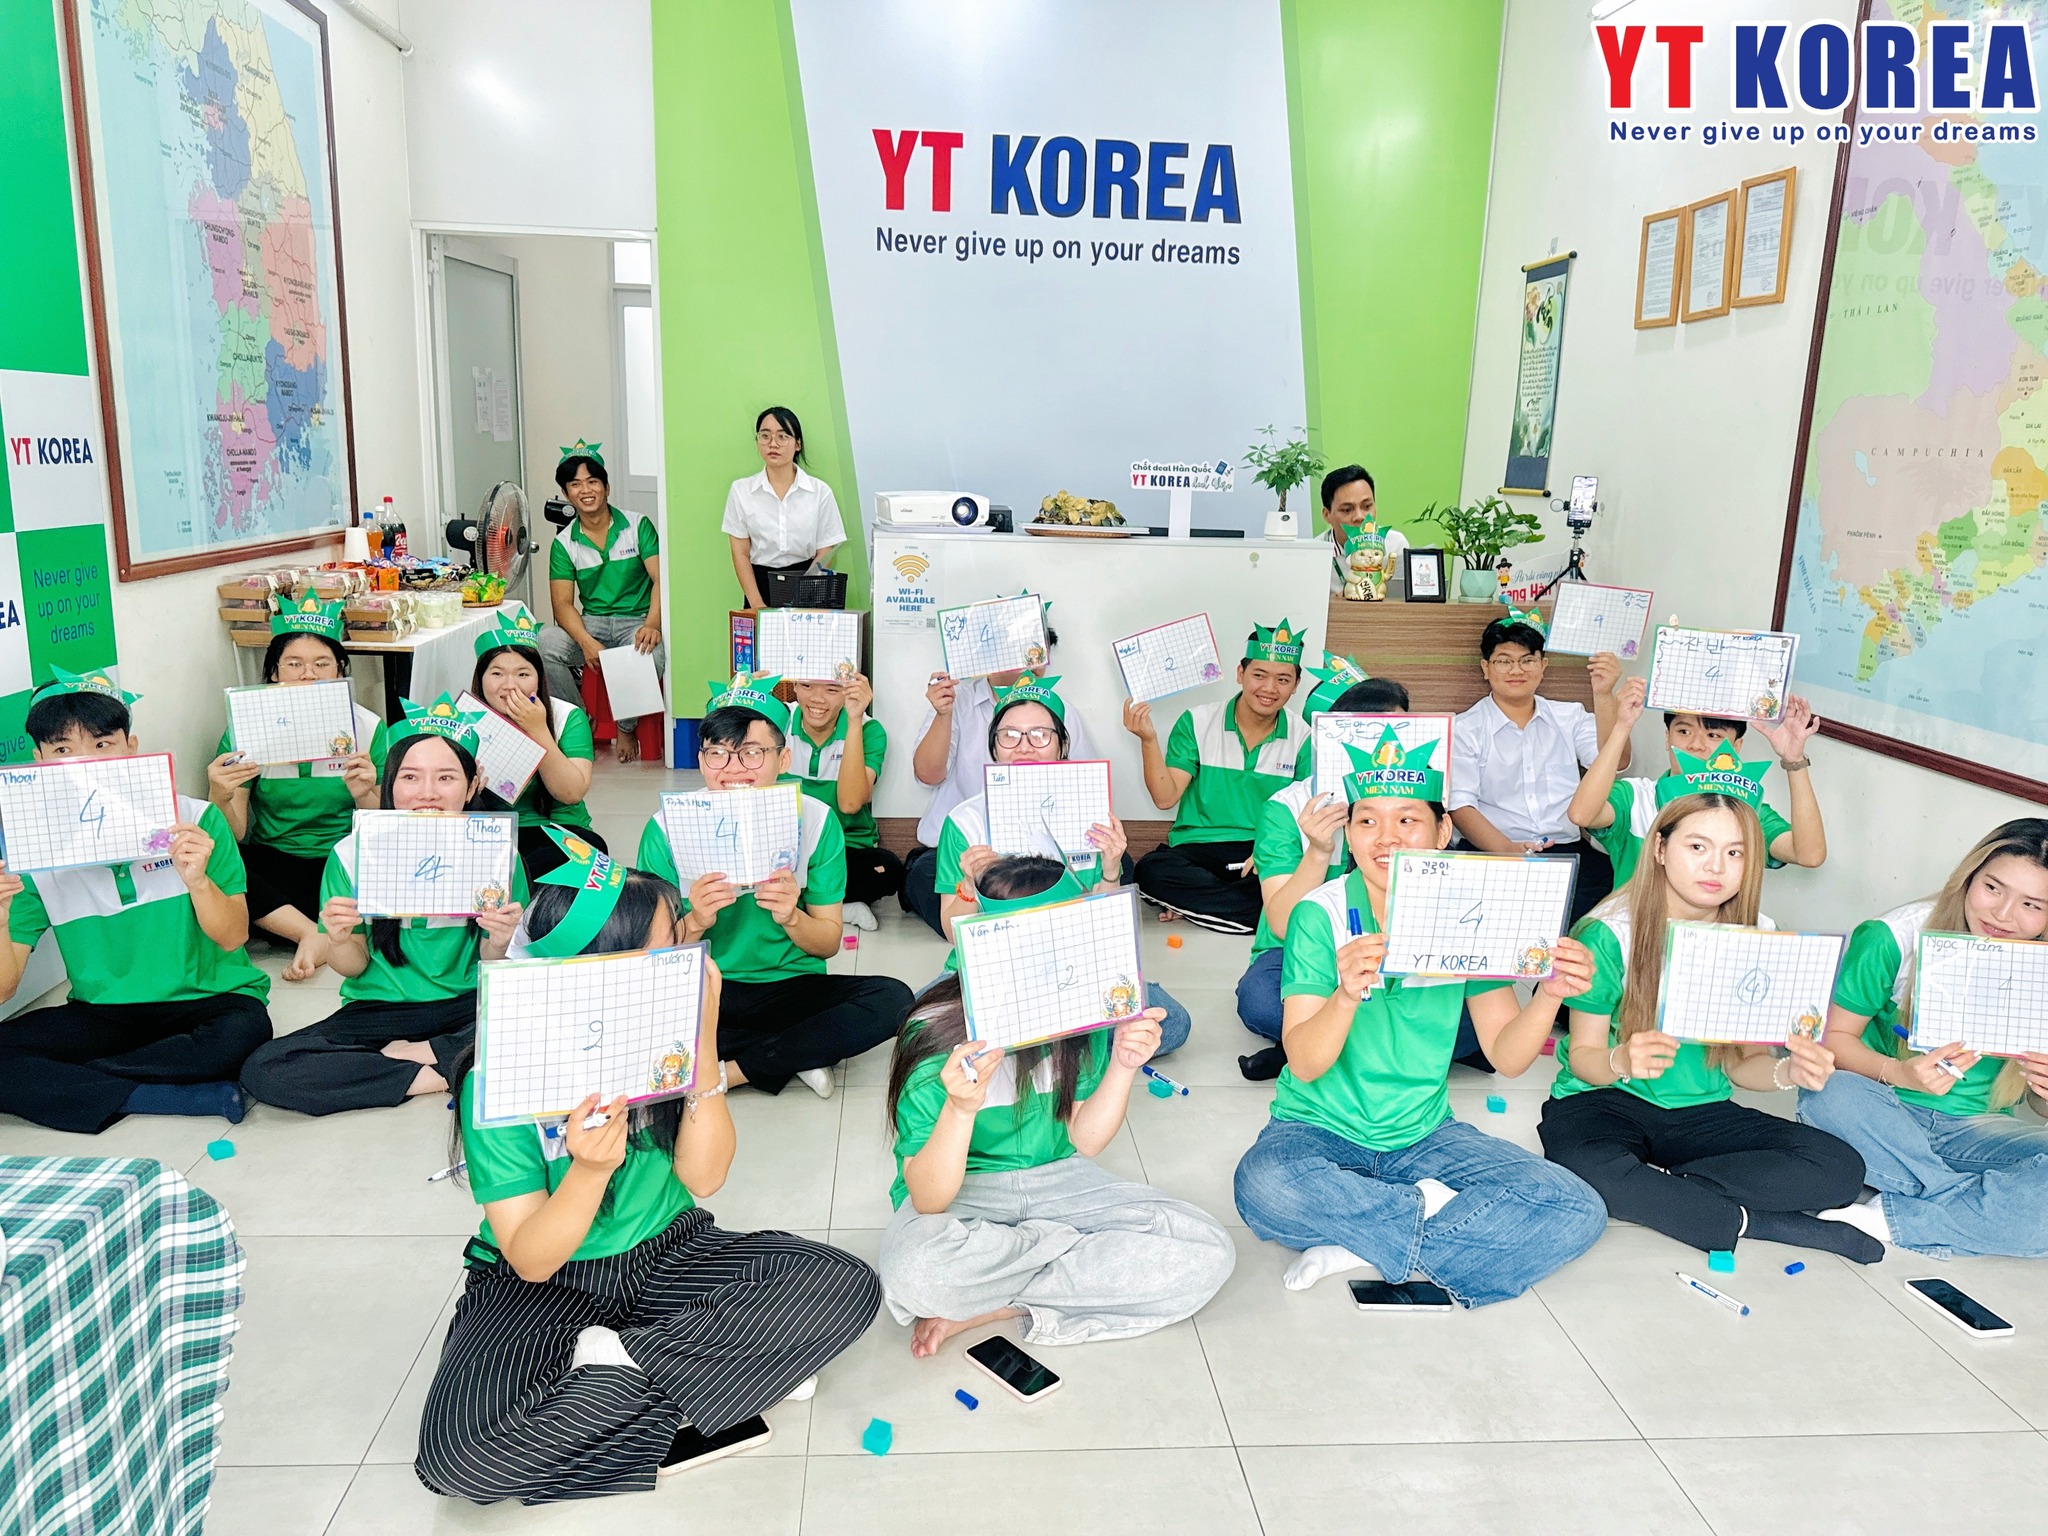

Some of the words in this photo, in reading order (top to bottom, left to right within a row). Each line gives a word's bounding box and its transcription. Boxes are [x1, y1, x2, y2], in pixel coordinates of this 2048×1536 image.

[872, 128, 964, 213] YT
[990, 133, 1242, 224] KOREA
[876, 227, 948, 254] Never
[955, 230, 1006, 262] give
[1015, 237, 1044, 264] up
[1052, 240, 1081, 259] on
[1091, 242, 1144, 267] your
[1151, 239, 1241, 265] dreams
[10, 437, 32, 465] YT
[37, 437, 94, 465] KOREA
[1132, 461, 1151, 471] Chốt
[1153, 464, 1171, 472] deal
[1173, 464, 1190, 472] Hàn
[1191, 463, 1212, 473] Quốc
[1133, 474, 1147, 486] YT
[1150, 475, 1190, 488] KOREA
[33, 567, 71, 589] Never
[75, 565, 98, 588] give
[37, 599, 54, 621] up
[57, 596, 73, 615] on
[76, 592, 100, 617] your
[886, 596, 935, 604] AVAILABLE
[51, 618, 95, 644] dreams
[284, 614, 297, 623] YT
[299, 614, 335, 628] KOREA
[980, 624, 994, 647] 4
[1259, 642, 1272, 653] YT
[1274, 644, 1299, 655] KOREA
[1165, 657, 1178, 671] 2
[1705, 665, 1722, 683] 4
[276, 717, 292, 727] 4
[410, 718, 427, 727] YT
[1356, 771, 1374, 785] YT
[1375, 769, 1426, 784] KOREA
[1685, 772, 1709, 783] YT
[1711, 772, 1758, 797] KOREA
[79, 789, 106, 840] 4
[472, 818, 501, 835] Thảo
[716, 818, 738, 852] 4
[142, 863, 153, 872] YT
[584, 867, 606, 892] YT
[1459, 900, 1484, 933] 4
[1412, 954, 1434, 970] YT
[1440, 955, 1488, 971] KOREA
[1058, 965, 1078, 990] 2
